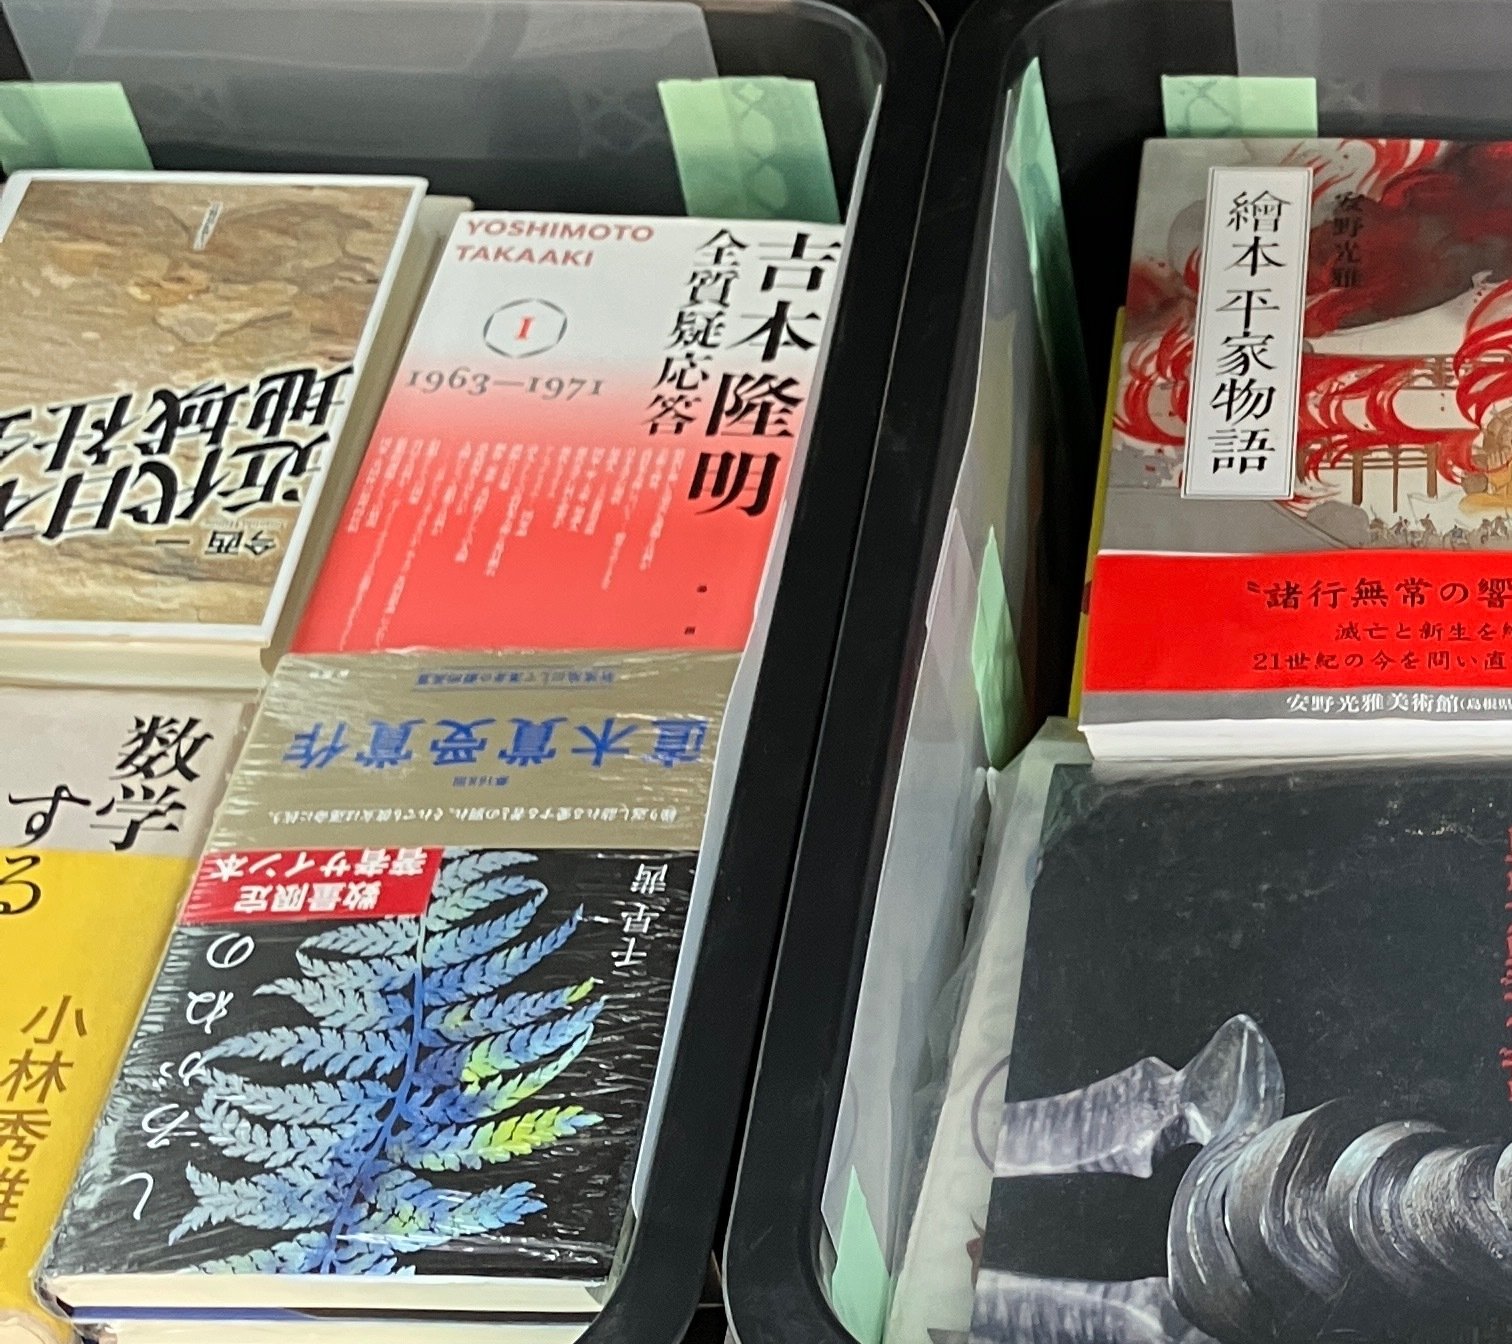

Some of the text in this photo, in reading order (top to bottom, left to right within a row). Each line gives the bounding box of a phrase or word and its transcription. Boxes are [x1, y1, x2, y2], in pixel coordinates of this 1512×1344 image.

[455, 243, 594, 268] TAKAAKI
[465, 218, 655, 246] YOSHIMOTO
[643, 227, 749, 437] 全質疑応答
[688, 232, 842, 517] 吉本隆明
[89, 713, 216, 854] 数学
[282, 715, 709, 770] 直木賞受賞作
[211, 849, 431, 882] 著者サイン本
[231, 881, 383, 914] 数量限定
[609, 861, 670, 970] 千早茜
[120, 933, 258, 1223] しろがねの
